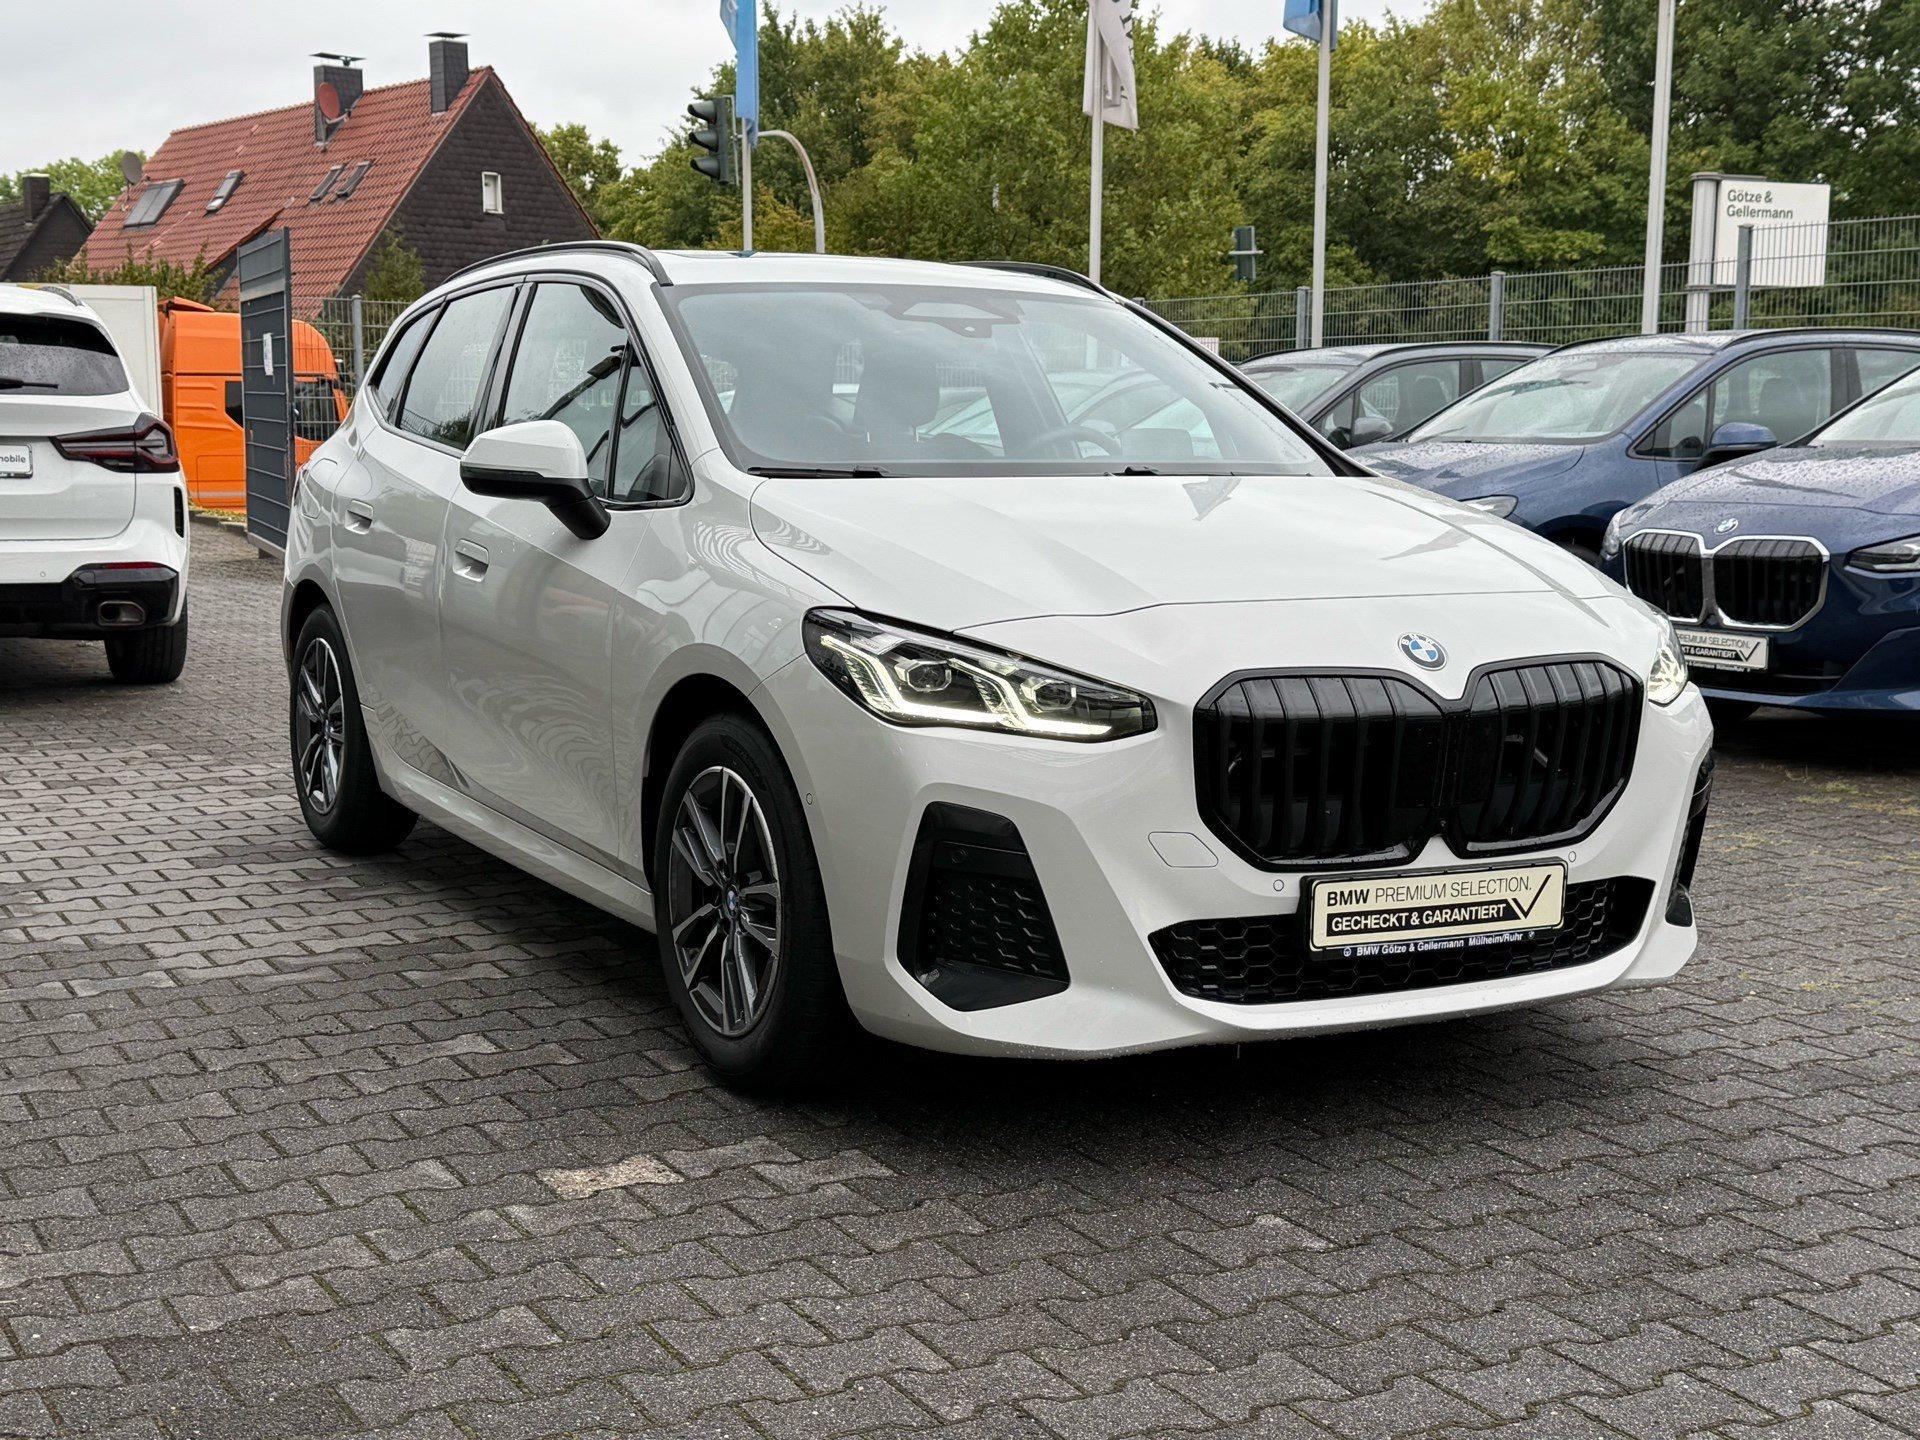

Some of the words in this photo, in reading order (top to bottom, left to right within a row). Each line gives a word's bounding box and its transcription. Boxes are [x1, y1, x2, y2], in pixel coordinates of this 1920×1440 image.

[1728, 189, 1762, 203] Götze
[1764, 191, 1773, 203] &
[1727, 204, 1793, 219] Gellermann
[1695, 647, 1736, 658] GARANTIERT
[1327, 889, 1370, 907] BMW
[1375, 883, 1447, 903] PREMIUM
[1332, 912, 1409, 932] GECHECKT
[1410, 911, 1420, 926] &
[1422, 904, 1507, 924] GARANTIERT
[1356, 945, 1380, 956] BMW
[1381, 943, 1407, 954] Götze
[1409, 942, 1416, 952] &
[1417, 939, 1464, 952] Gellermann
[1468, 933, 1523, 946] Mülheim/Ruhr
